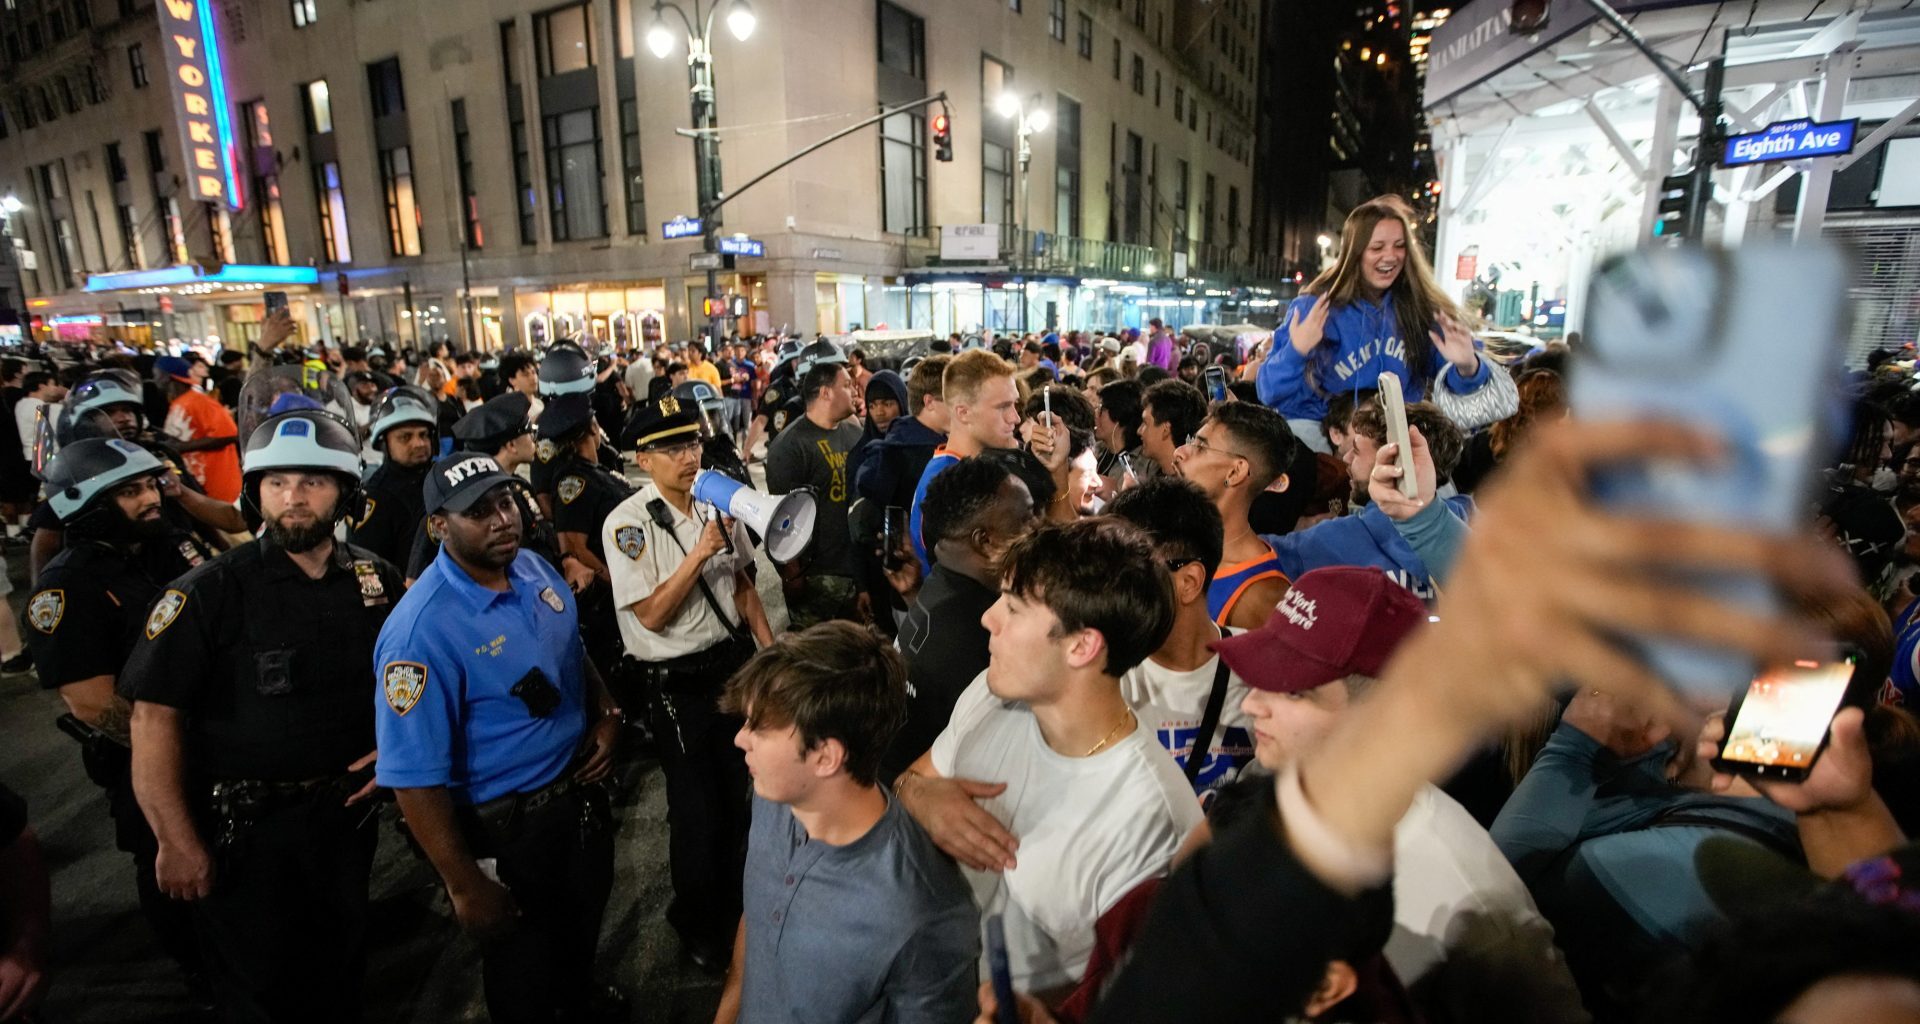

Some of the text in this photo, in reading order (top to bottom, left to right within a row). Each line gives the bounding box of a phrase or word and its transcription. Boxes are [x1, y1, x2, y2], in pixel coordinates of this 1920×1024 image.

[174, 35, 222, 197] YORKER
[1733, 131, 1841, 160] Eighth Ave
[444, 457, 499, 487] NYPD
